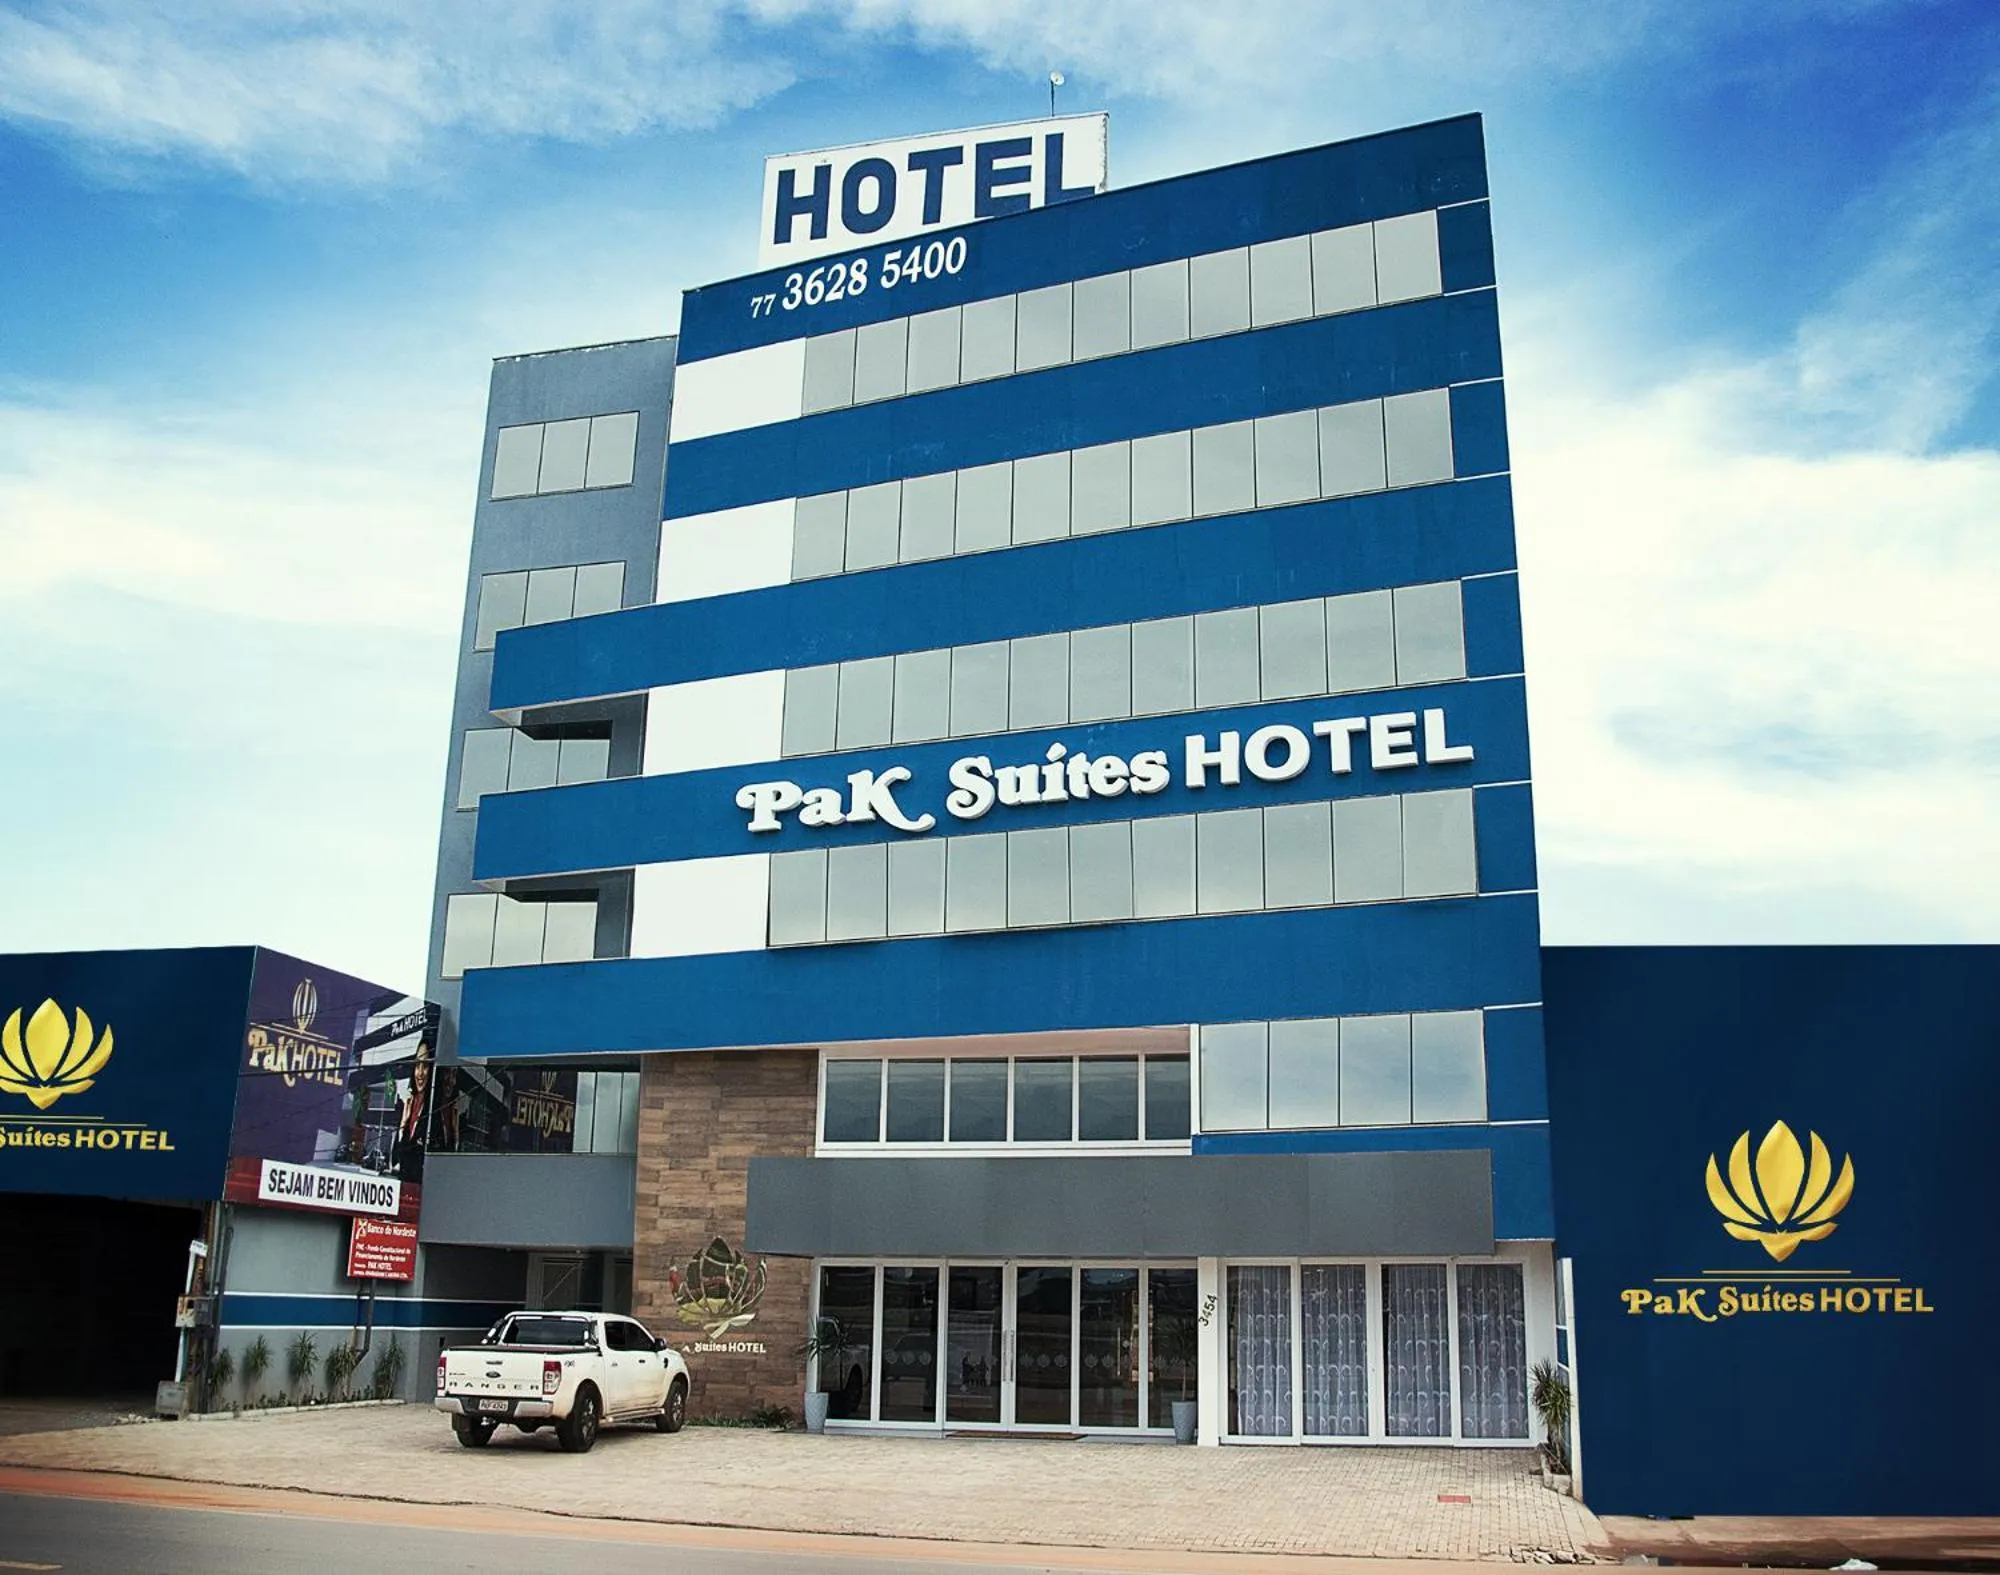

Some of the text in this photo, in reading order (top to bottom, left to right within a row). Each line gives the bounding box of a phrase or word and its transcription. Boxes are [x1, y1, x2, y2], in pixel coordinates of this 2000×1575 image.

[773, 132, 1096, 245] HOTEL
[750, 236, 967, 319] 77 3628 5400
[1185, 707, 1474, 788] HOTEL
[404, 1008, 428, 1032] HOTEL
[292, 1041, 344, 1086] HOTEL
[75, 1129, 175, 1150] HOTEL
[268, 1168, 393, 1207] SEJAM BEM VINDOS
[367, 1223, 384, 1235] Banco
[1198, 1294, 1218, 1327] 3454
[1820, 1287, 1934, 1313] HOTEL
[728, 1342, 766, 1354] HOTEL
[449, 1381, 540, 1391] RANGER
